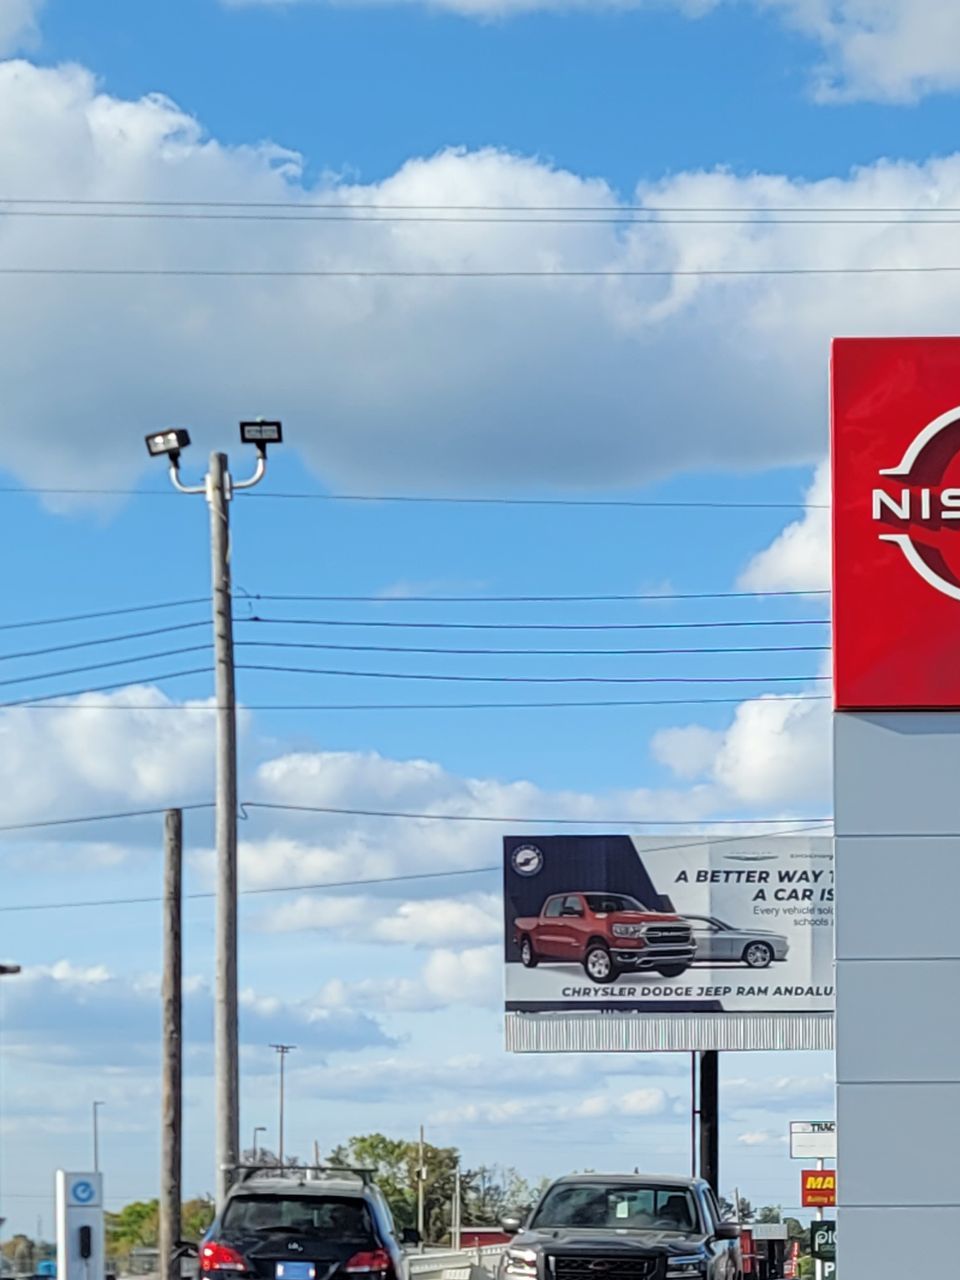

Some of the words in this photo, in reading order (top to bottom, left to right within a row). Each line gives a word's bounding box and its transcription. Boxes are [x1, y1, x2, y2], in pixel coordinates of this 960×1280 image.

[674, 870, 689, 883] A
[696, 870, 770, 883] BETTER
[778, 870, 824, 883] WAY
[752, 888, 767, 901] A
[774, 888, 814, 901] CAR
[753, 906, 780, 917] Every
[561, 986, 636, 997] CHRYSLER
[641, 986, 693, 997] DODGE
[696, 986, 732, 997] JEEP
[736, 986, 769, 997] RAM
[772, 986, 834, 996] ANDALU
